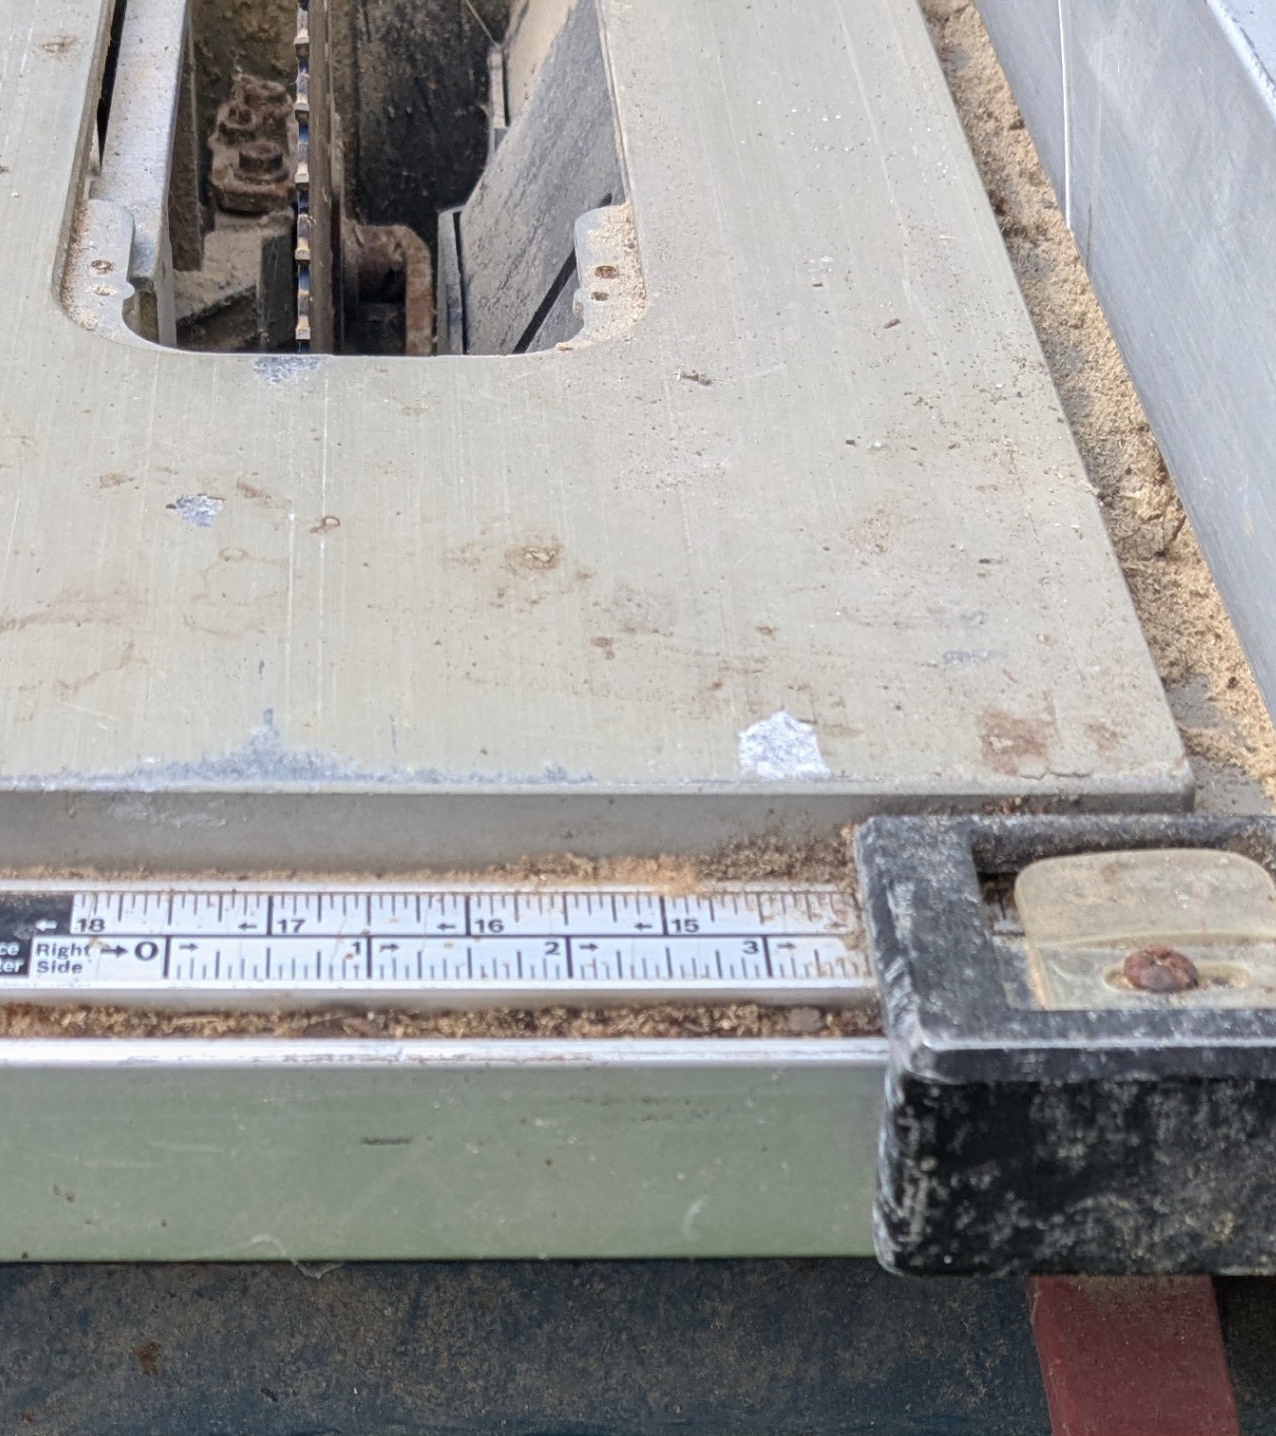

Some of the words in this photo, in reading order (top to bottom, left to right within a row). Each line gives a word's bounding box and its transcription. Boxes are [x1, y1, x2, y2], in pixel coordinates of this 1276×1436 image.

[75, 918, 106, 932] 18
[277, 919, 306, 933] 17
[474, 919, 505, 933] 16
[671, 919, 700, 933] 15
[36, 942, 91, 960] Right
[350, 942, 362, 956] 1
[543, 941, 561, 955] 2
[742, 940, 759, 955] 3
[36, 960, 84, 973] Side
